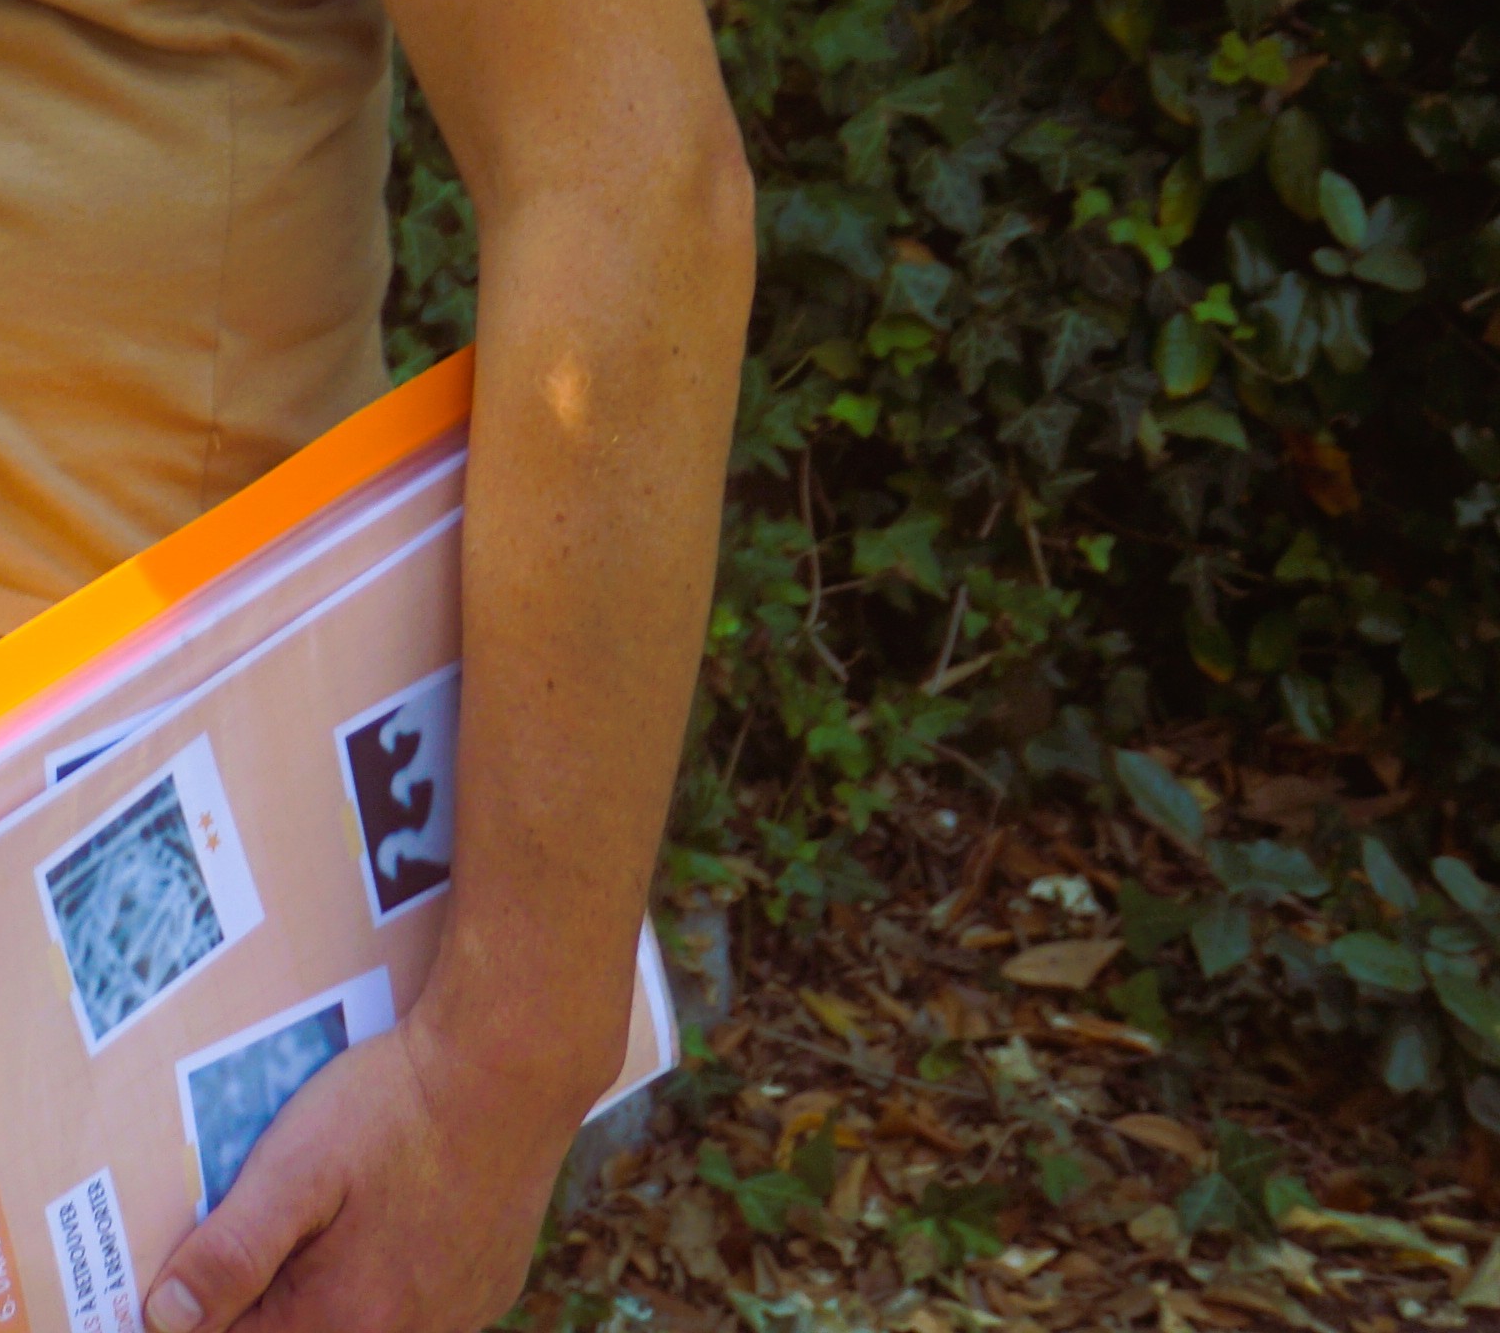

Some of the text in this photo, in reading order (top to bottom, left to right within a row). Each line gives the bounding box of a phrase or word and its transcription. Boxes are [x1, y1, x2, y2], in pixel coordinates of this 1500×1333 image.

[59, 1199, 94, 1301] RETROUVER
[87, 1177, 122, 1279] REMPORTER
[74, 1295, 97, 1317] À
[103, 1273, 125, 1295] À
